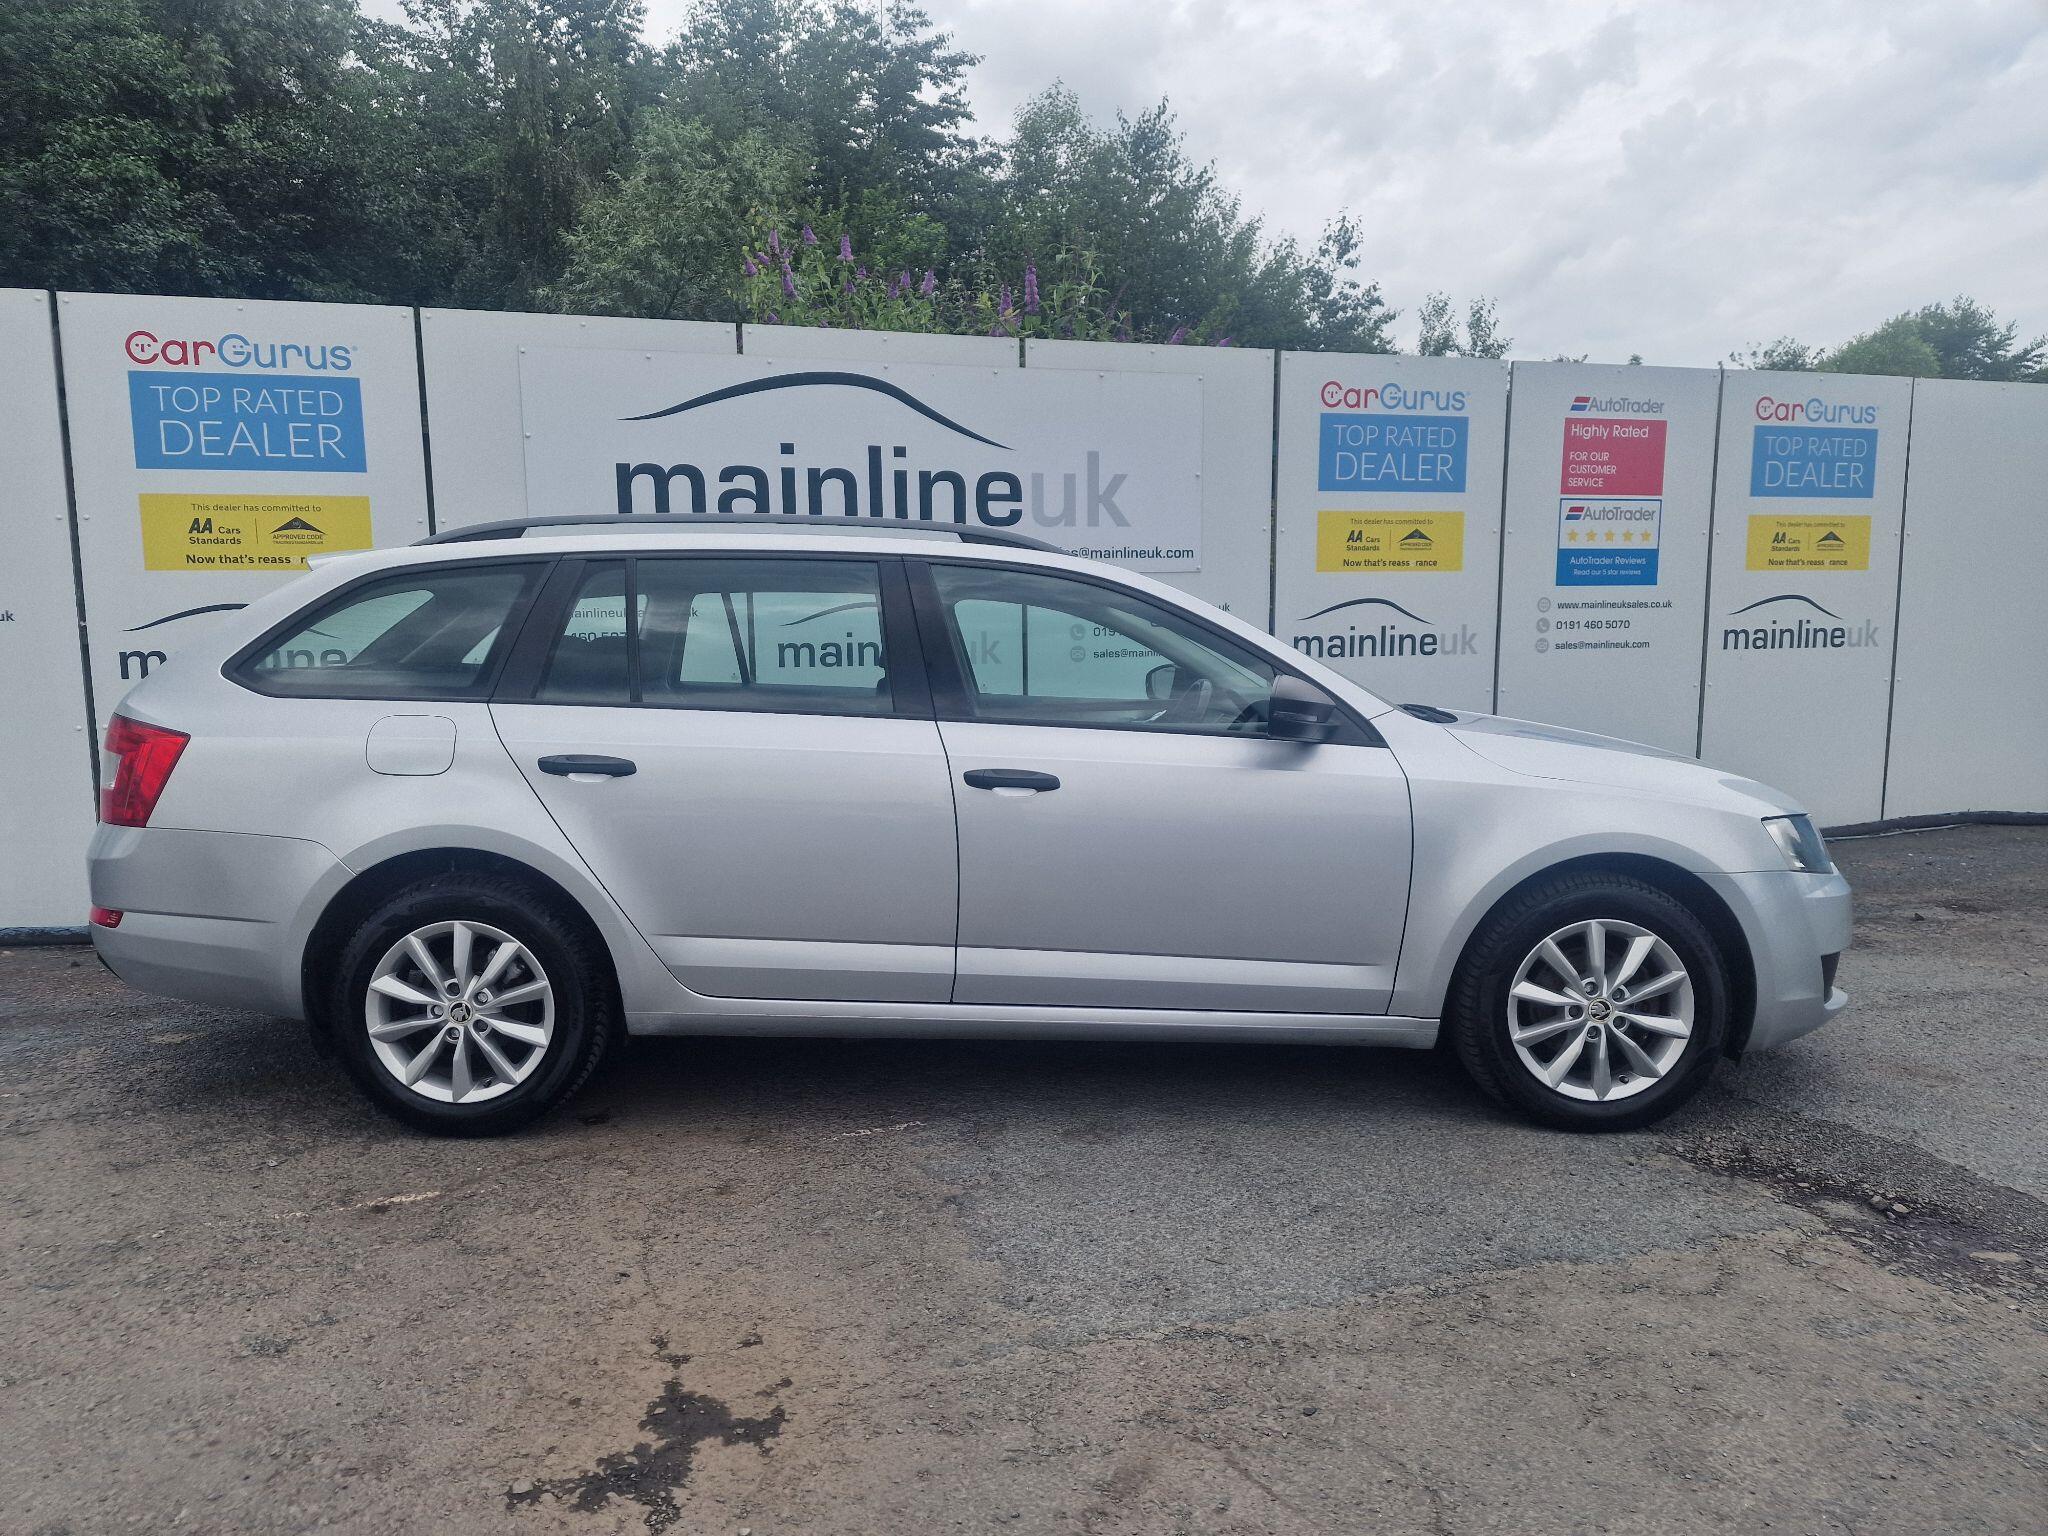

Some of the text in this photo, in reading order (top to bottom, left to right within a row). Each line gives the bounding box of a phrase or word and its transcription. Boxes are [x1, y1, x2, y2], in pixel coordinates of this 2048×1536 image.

[125, 331, 352, 370] CarGurus
[150, 386, 343, 416] TOP RATED
[1321, 380, 1466, 411] CarGurus
[1589, 397, 1664, 413] AutoTrader
[1756, 396, 1876, 424] CarGurus
[160, 420, 346, 458] DEALER
[1333, 425, 1456, 447] TOP RATED
[1571, 424, 1648, 439] Highly Rated
[1765, 436, 1867, 457] TOP RATED
[1570, 452, 1609, 460] FOR OUR
[1335, 452, 1453, 481] DEALER
[1569, 465, 1616, 474] CUSTOMER
[1568, 478, 1604, 486] SERVICE
[1765, 461, 1864, 488] DEALER
[616, 442, 1132, 527] mainlineuk
[262, 504, 310, 512] committed
[1583, 506, 1656, 520] AutoTrader
[189, 518, 240, 534] AA Cars
[189, 536, 241, 544] Standards
[1347, 530, 1362, 542] AA
[1773, 532, 1786, 543] AA
[186, 555, 214, 563] Now
[219, 554, 254, 563] that's
[1570, 556, 1613, 564] AutoTrader
[1558, 600, 1672, 609] www.mainlineuksales.co.uk
[1557, 620, 1630, 629] 0191 460 5070
[1293, 624, 1477, 657] mainlineuk
[1723, 619, 1879, 650] mainlineuk
[1555, 640, 1649, 649] sales@mainlineuk.com
